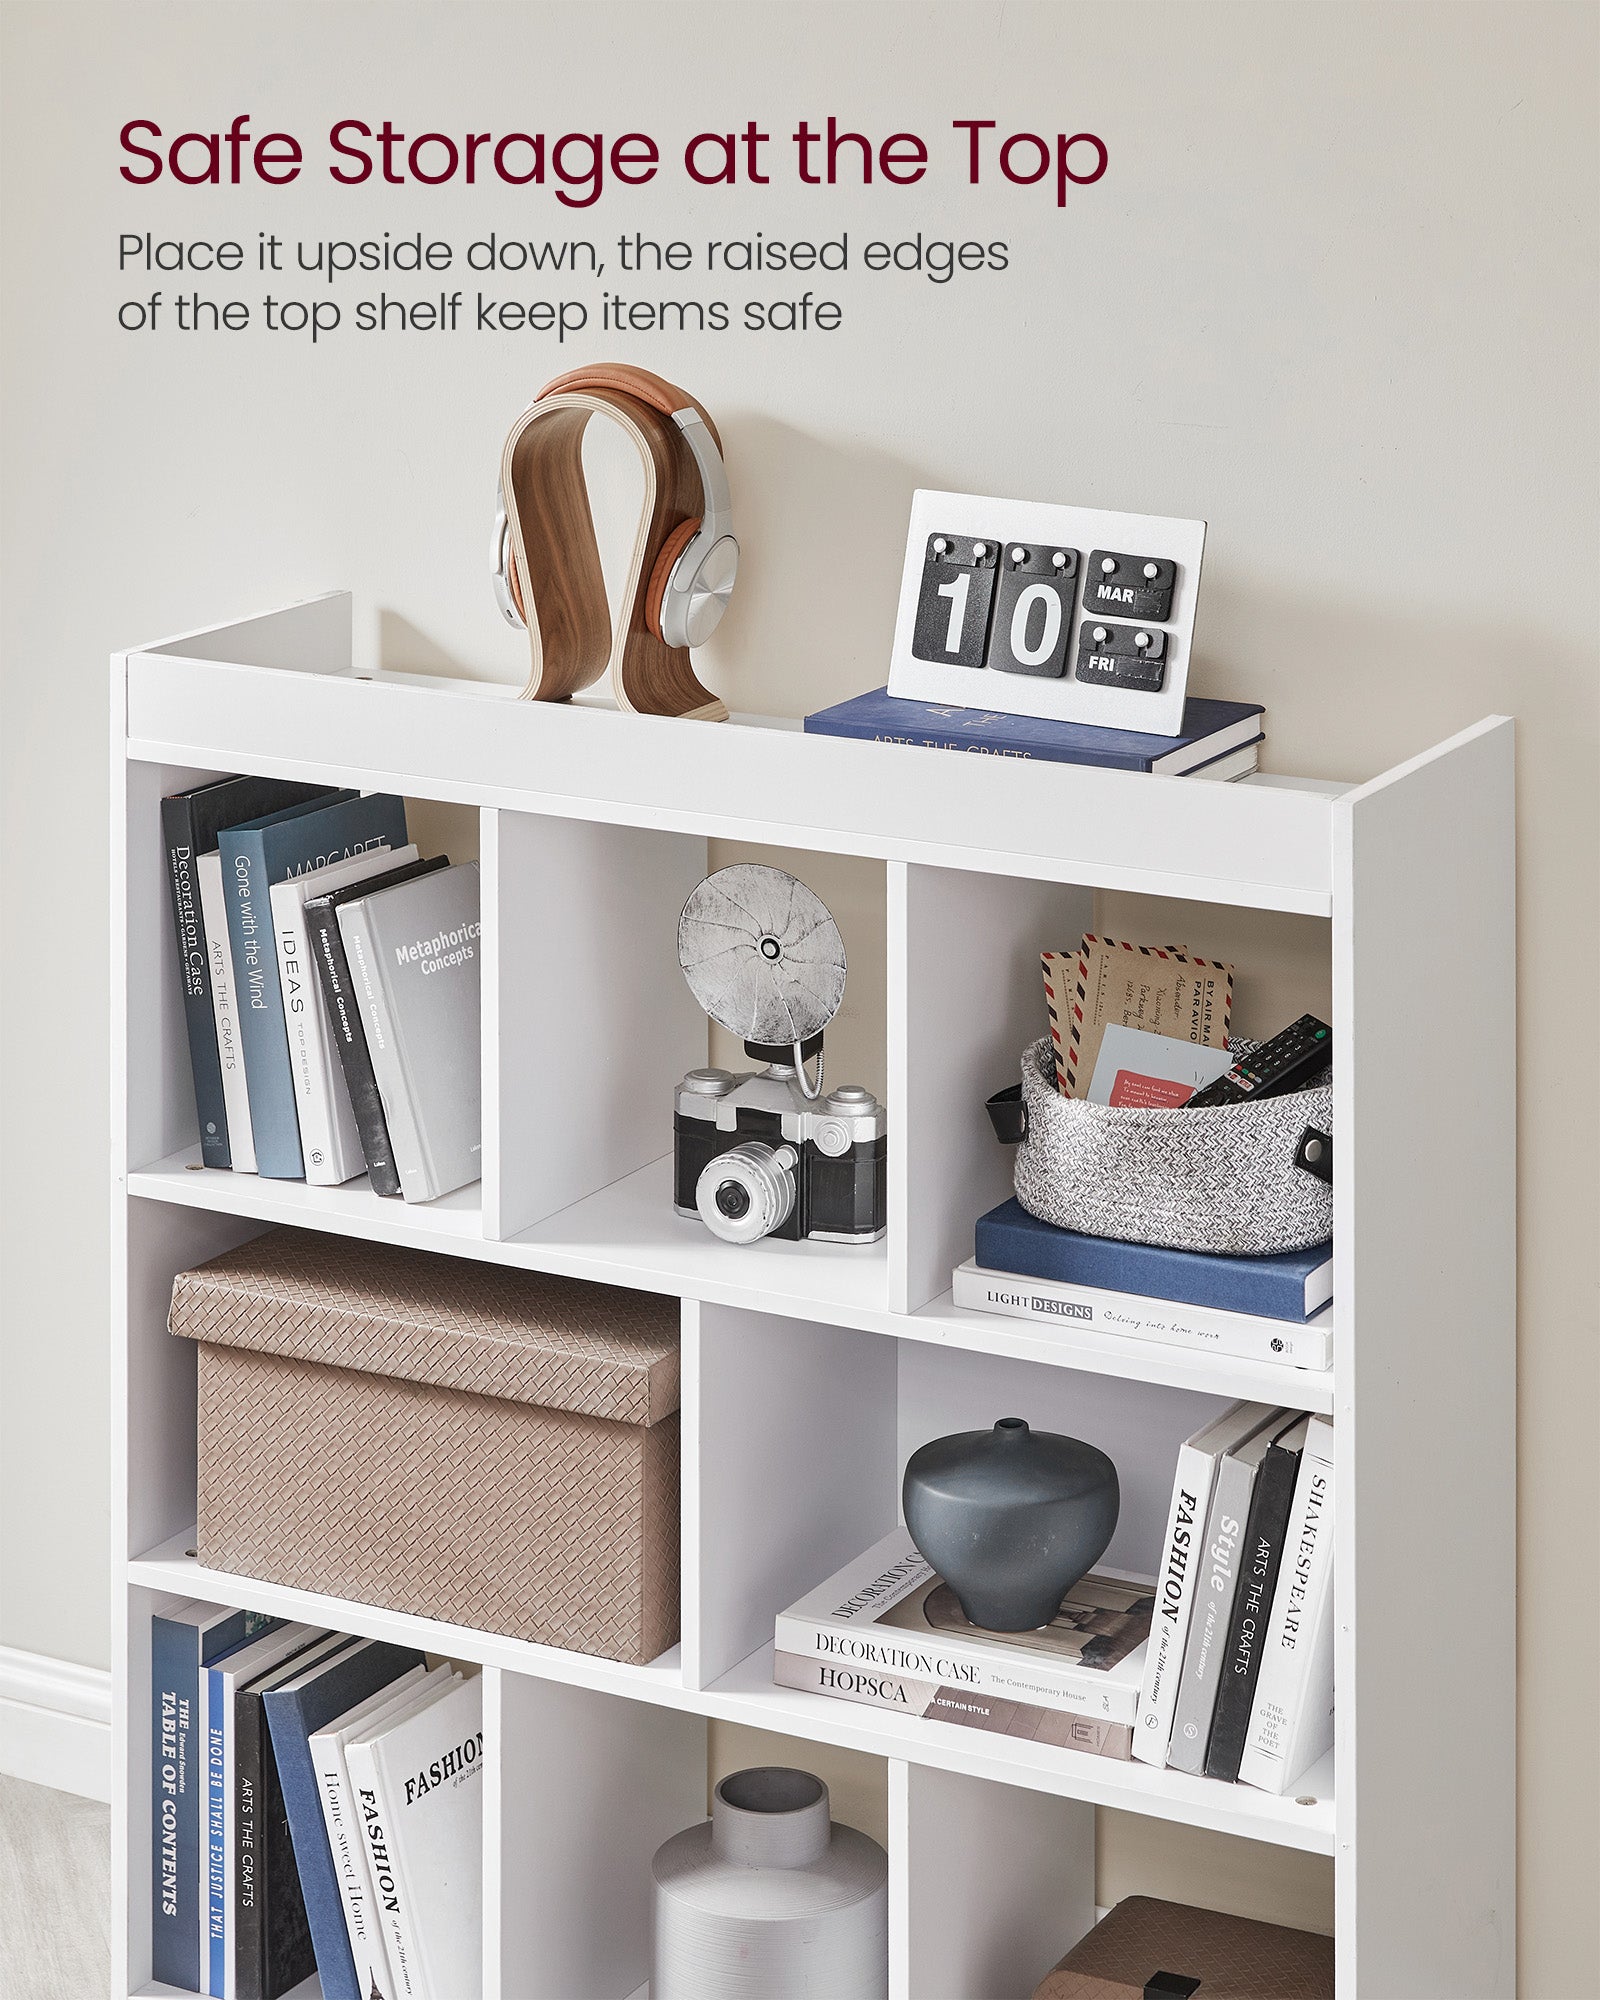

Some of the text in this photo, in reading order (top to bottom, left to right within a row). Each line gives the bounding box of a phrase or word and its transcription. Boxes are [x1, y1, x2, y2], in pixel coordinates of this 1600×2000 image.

[1096, 584, 1134, 604] MAR
[1088, 655, 1115, 673] FRI
[174, 878, 185, 924] RESTAURANTS
[180, 927, 188, 958] GARDENS
[184, 961, 193, 995] GETAWAYS
[176, 846, 204, 996] Decoration Case
[234, 855, 268, 1009] Gone with the Wind
[395, 921, 481, 966] Metaphorica
[282, 931, 304, 1014] IDEAS
[319, 928, 353, 1043] Metaphorical Concepts
[420, 945, 474, 976] Concepts
[212, 940, 236, 1070] ARTS THE CRAFTS
[353, 935, 385, 1050] Metaphorical Concepts
[1190, 980, 1202, 1044] PAR AVIO
[1202, 980, 1215, 1048] BY AIR MAI
[297, 1022, 311, 1095] TOP DESIGN
[987, 1290, 1092, 1321] LIGHT DESIGNS
[831, 1562, 918, 1619] DECORATION
[1281, 1474, 1327, 1650] SHAKESPEARE
[1151, 1488, 1197, 1705] FASHION of the 21th century
[1195, 1515, 1240, 1681] Style of the 21th century
[1234, 1536, 1272, 1676] ARTS THE CRAFTS
[816, 1632, 981, 1685] DECORATION CASE
[819, 1667, 908, 1704] HOPSCA
[991, 1674, 1087, 1702] The Contemporary House
[179, 1699, 190, 1730] THE
[936, 1698, 967, 1712] CERTAIN
[967, 1704, 990, 1717] STYLE
[1259, 1709, 1288, 1727] GRAVE
[1262, 1727, 1280, 1741] THE
[1265, 1720, 1279, 1731] OF
[1266, 1702, 1284, 1716] THE
[1257, 1735, 1281, 1750] POET
[162, 1692, 178, 1917] TABLE OF CONTENTS
[211, 1728, 224, 1940] THAT JUSTICE SHALL BE DONE
[242, 1777, 254, 1907] ARTS THE CRAFTS
[324, 1773, 367, 1941] Home sweet Home
[359, 1788, 401, 1914] FASHION
[392, 1919, 398, 1930] of
[393, 1929, 402, 1945] the
[400, 1962, 412, 1996] century
